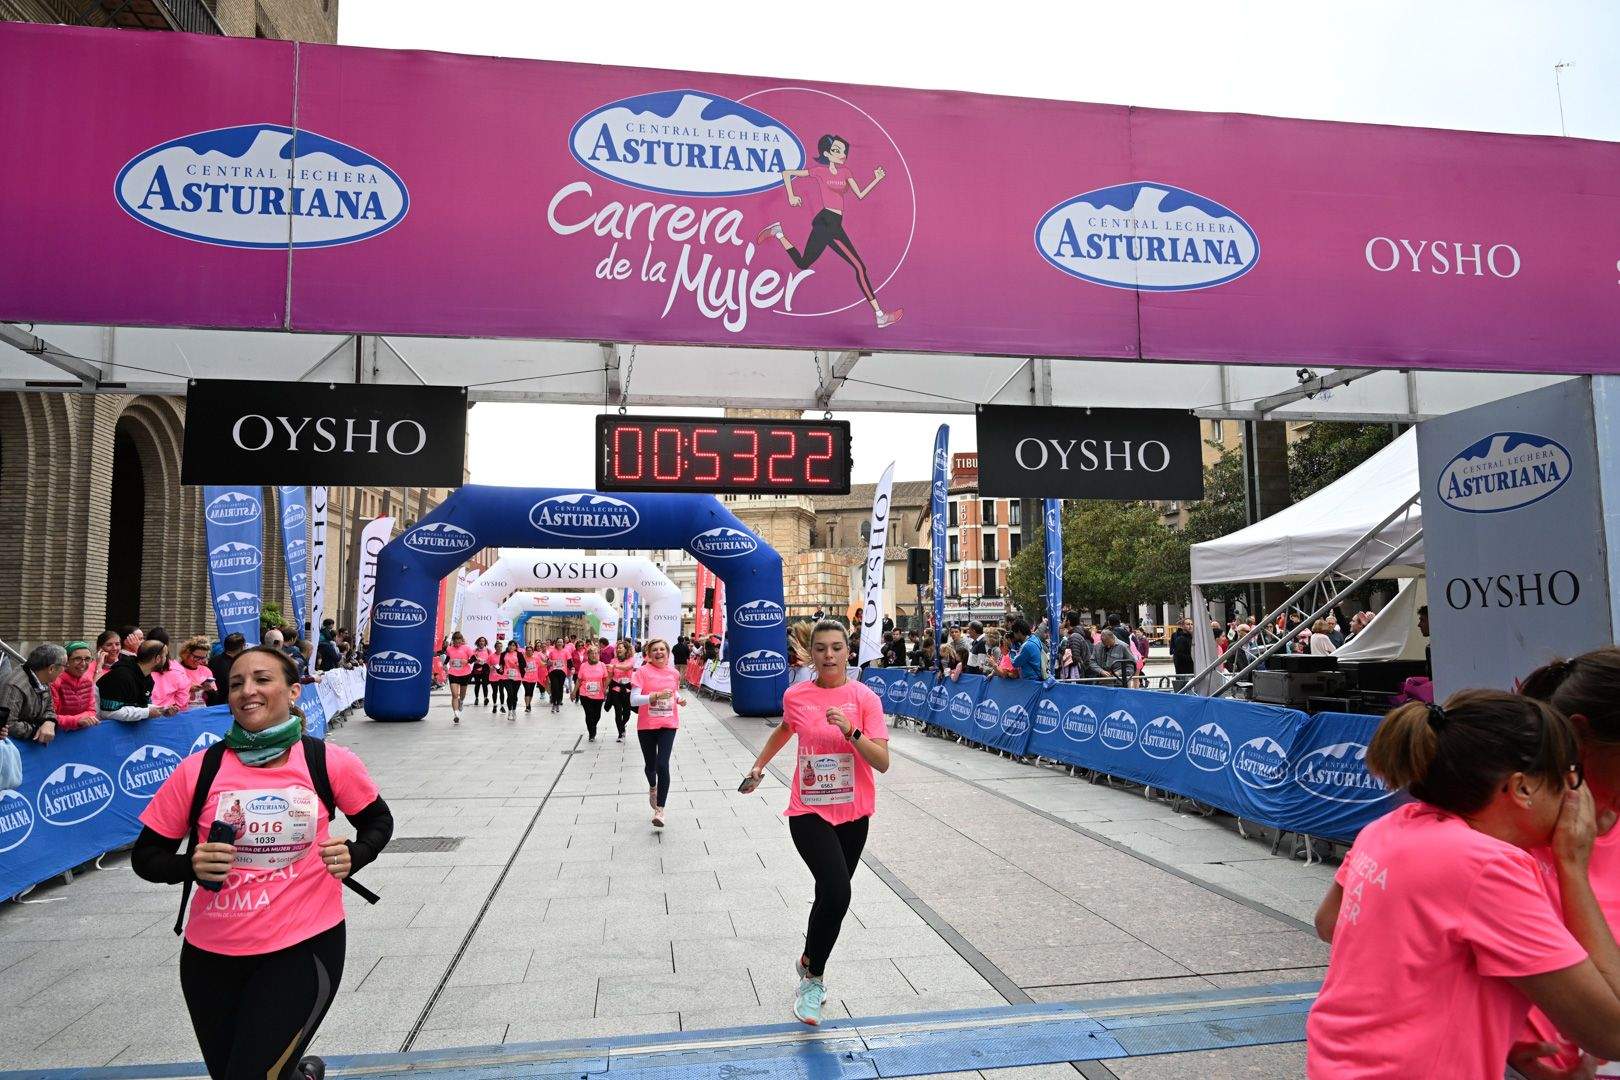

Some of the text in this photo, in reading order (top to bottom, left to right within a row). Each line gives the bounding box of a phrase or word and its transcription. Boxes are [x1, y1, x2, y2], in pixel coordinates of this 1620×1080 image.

[626, 122, 780, 143] CENTRAL LECHERA
[587, 122, 786, 173] ASTURIANA
[186, 164, 378, 185] CENTRAL LECHERA
[137, 164, 387, 220] ASTURIANA
[547, 181, 744, 246] Carrera
[1088, 217, 1235, 234] CENTRAL LECHERA
[1053, 217, 1244, 265] ASTURIANA
[1365, 236, 1521, 278] OYSHO
[595, 241, 816, 333] de la Mujer
[232, 414, 427, 456] OYSHO
[1014, 437, 1171, 472] OYSHO
[1463, 449, 1554, 474] CENTRAL LECHERA
[1446, 460, 1562, 500] ASTURIANA
[537, 506, 631, 528] ASTURIANA
[960, 504, 968, 544] HOTEL
[408, 533, 470, 548] ASTURIANA
[696, 538, 753, 551] ASTURIANA
[532, 561, 618, 579] OYSHO
[864, 493, 888, 628] OYSHO
[641, 579, 667, 587] OYSHO
[1445, 569, 1580, 610] OYSHO
[374, 608, 423, 622] ASTURIANA
[737, 610, 782, 622] ASTURIANA
[369, 661, 417, 674] ASTURIANA
[739, 660, 784, 673] ASTURIANA
[1063, 715, 1094, 734] ASTURIANA
[1101, 723, 1134, 742] ASTURIANA
[1141, 729, 1180, 751] ASTURIANA
[125, 763, 179, 791] ASTURIAN
[132, 761, 154, 772] CENTRAL
[1300, 760, 1388, 792] ASTURIAN
[817, 774, 836, 782] 016
[44, 783, 111, 818] ASTURIANA
[51, 784, 76, 796] CENTRAL
[249, 801, 287, 811] ASTURIANA
[248, 821, 283, 834] 016
[255, 836, 276, 845] 1039
